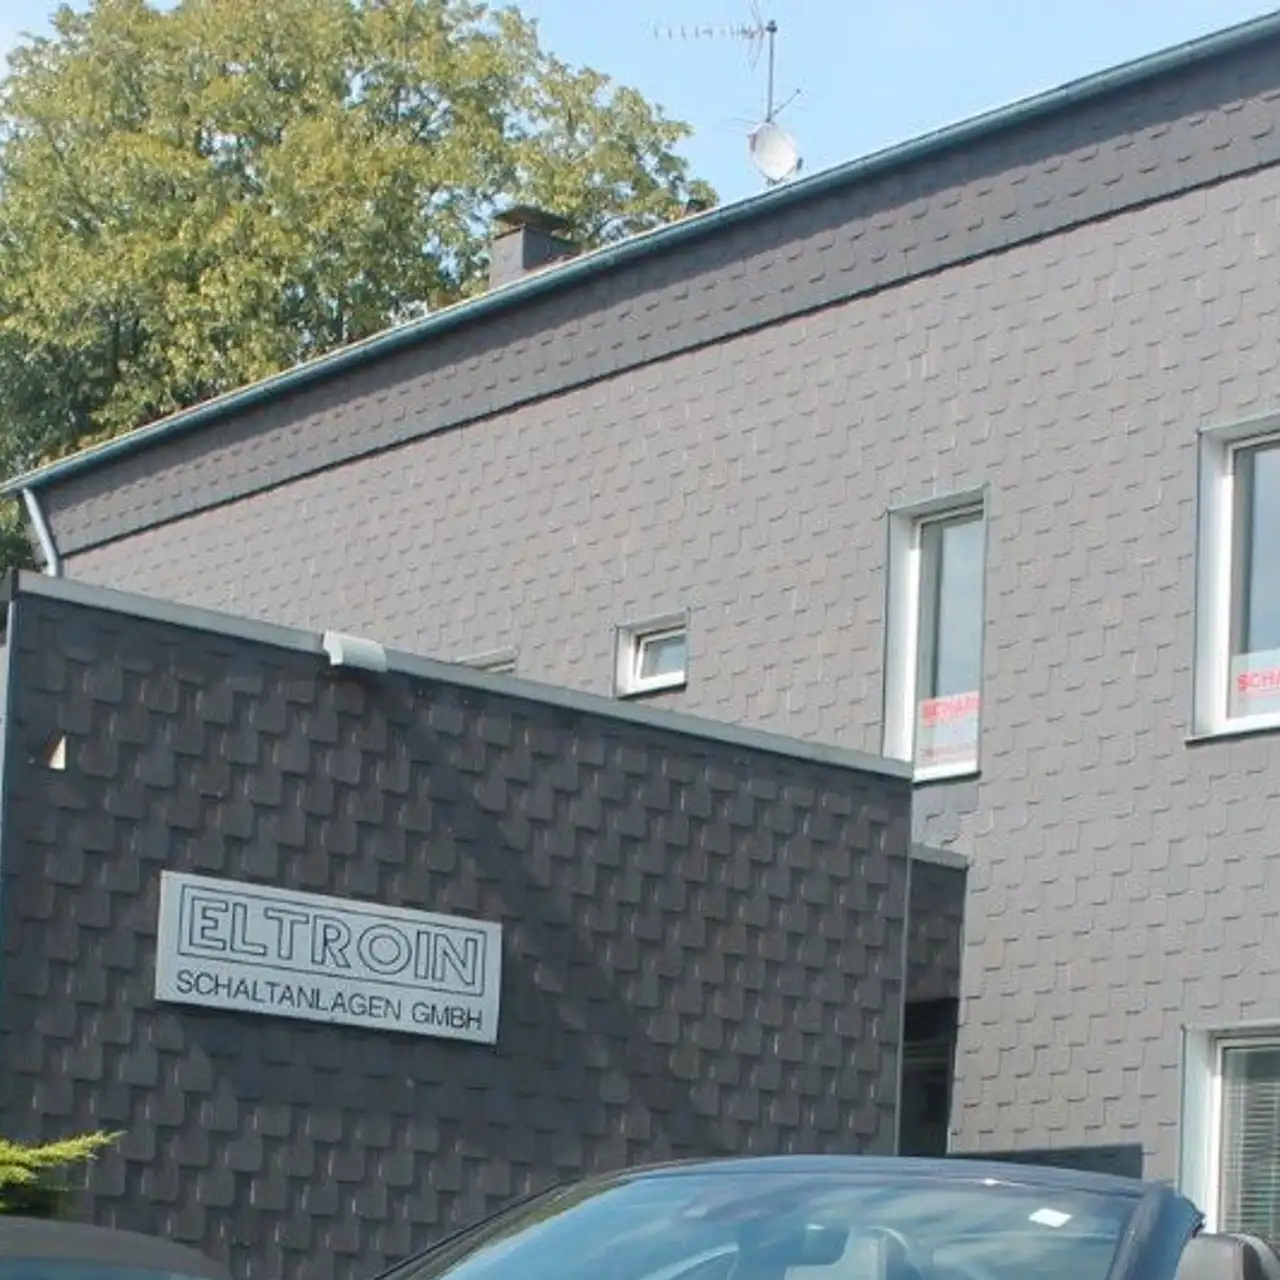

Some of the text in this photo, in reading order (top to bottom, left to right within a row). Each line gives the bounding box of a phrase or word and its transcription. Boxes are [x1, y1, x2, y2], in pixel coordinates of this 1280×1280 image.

[189, 896, 478, 985] ELTROIN
[177, 969, 483, 1030] SCHALTANLAGEN GMBH
